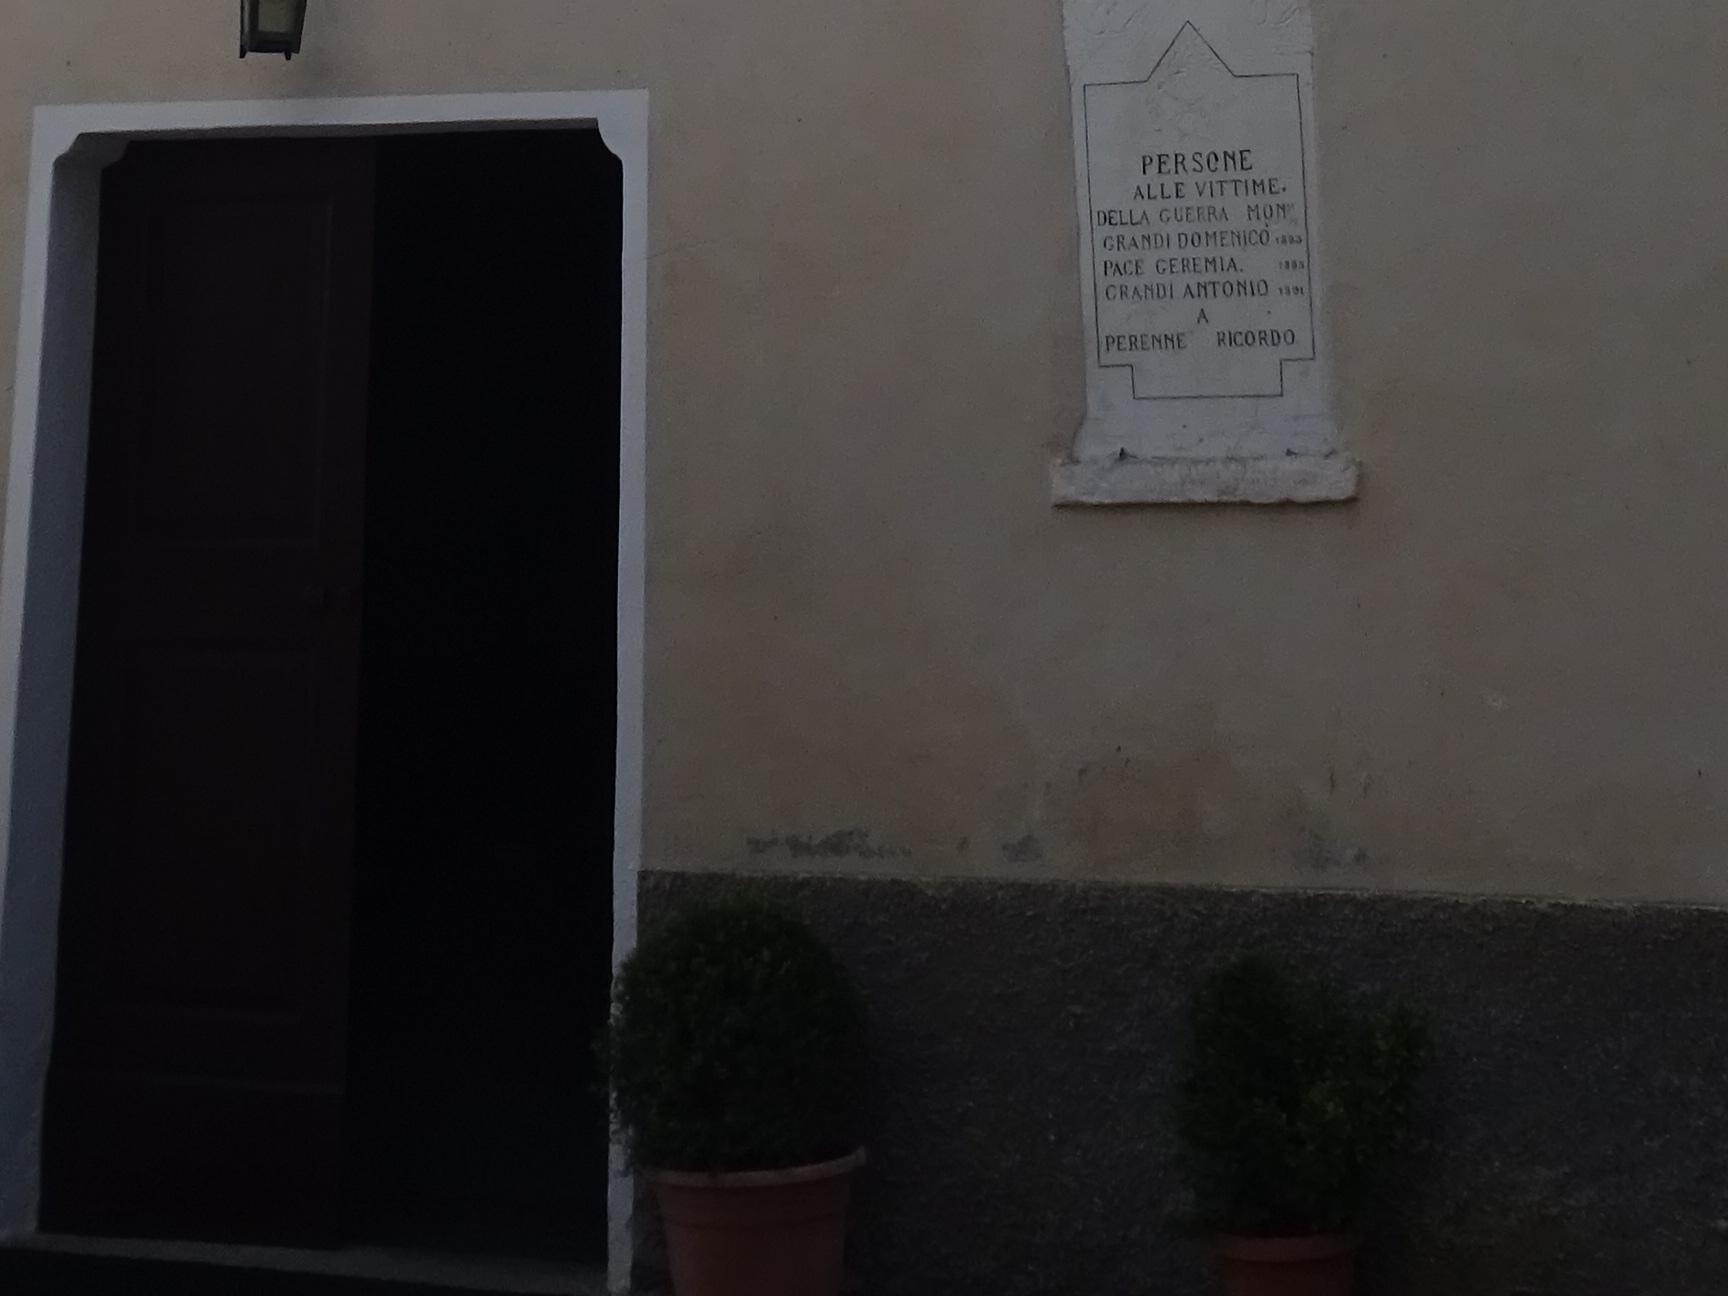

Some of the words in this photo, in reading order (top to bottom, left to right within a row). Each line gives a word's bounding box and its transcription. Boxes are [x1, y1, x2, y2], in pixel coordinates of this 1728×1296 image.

[1141, 149, 1253, 175] PERSONE
[1133, 182, 1186, 201] ALLE
[1097, 209, 1151, 227] DELLA
[1159, 205, 1230, 224] GUERRA
[1103, 233, 1170, 252] GRANDI
[1177, 229, 1271, 249] DOMENICO
[1103, 258, 1145, 277] PACE
[1106, 283, 1174, 301] GRANDI
[1183, 279, 1270, 299] ANTONIO
[1197, 308, 1209, 324] A
[1105, 332, 1187, 353] PERENNE
[1216, 328, 1296, 348] RICORDO
